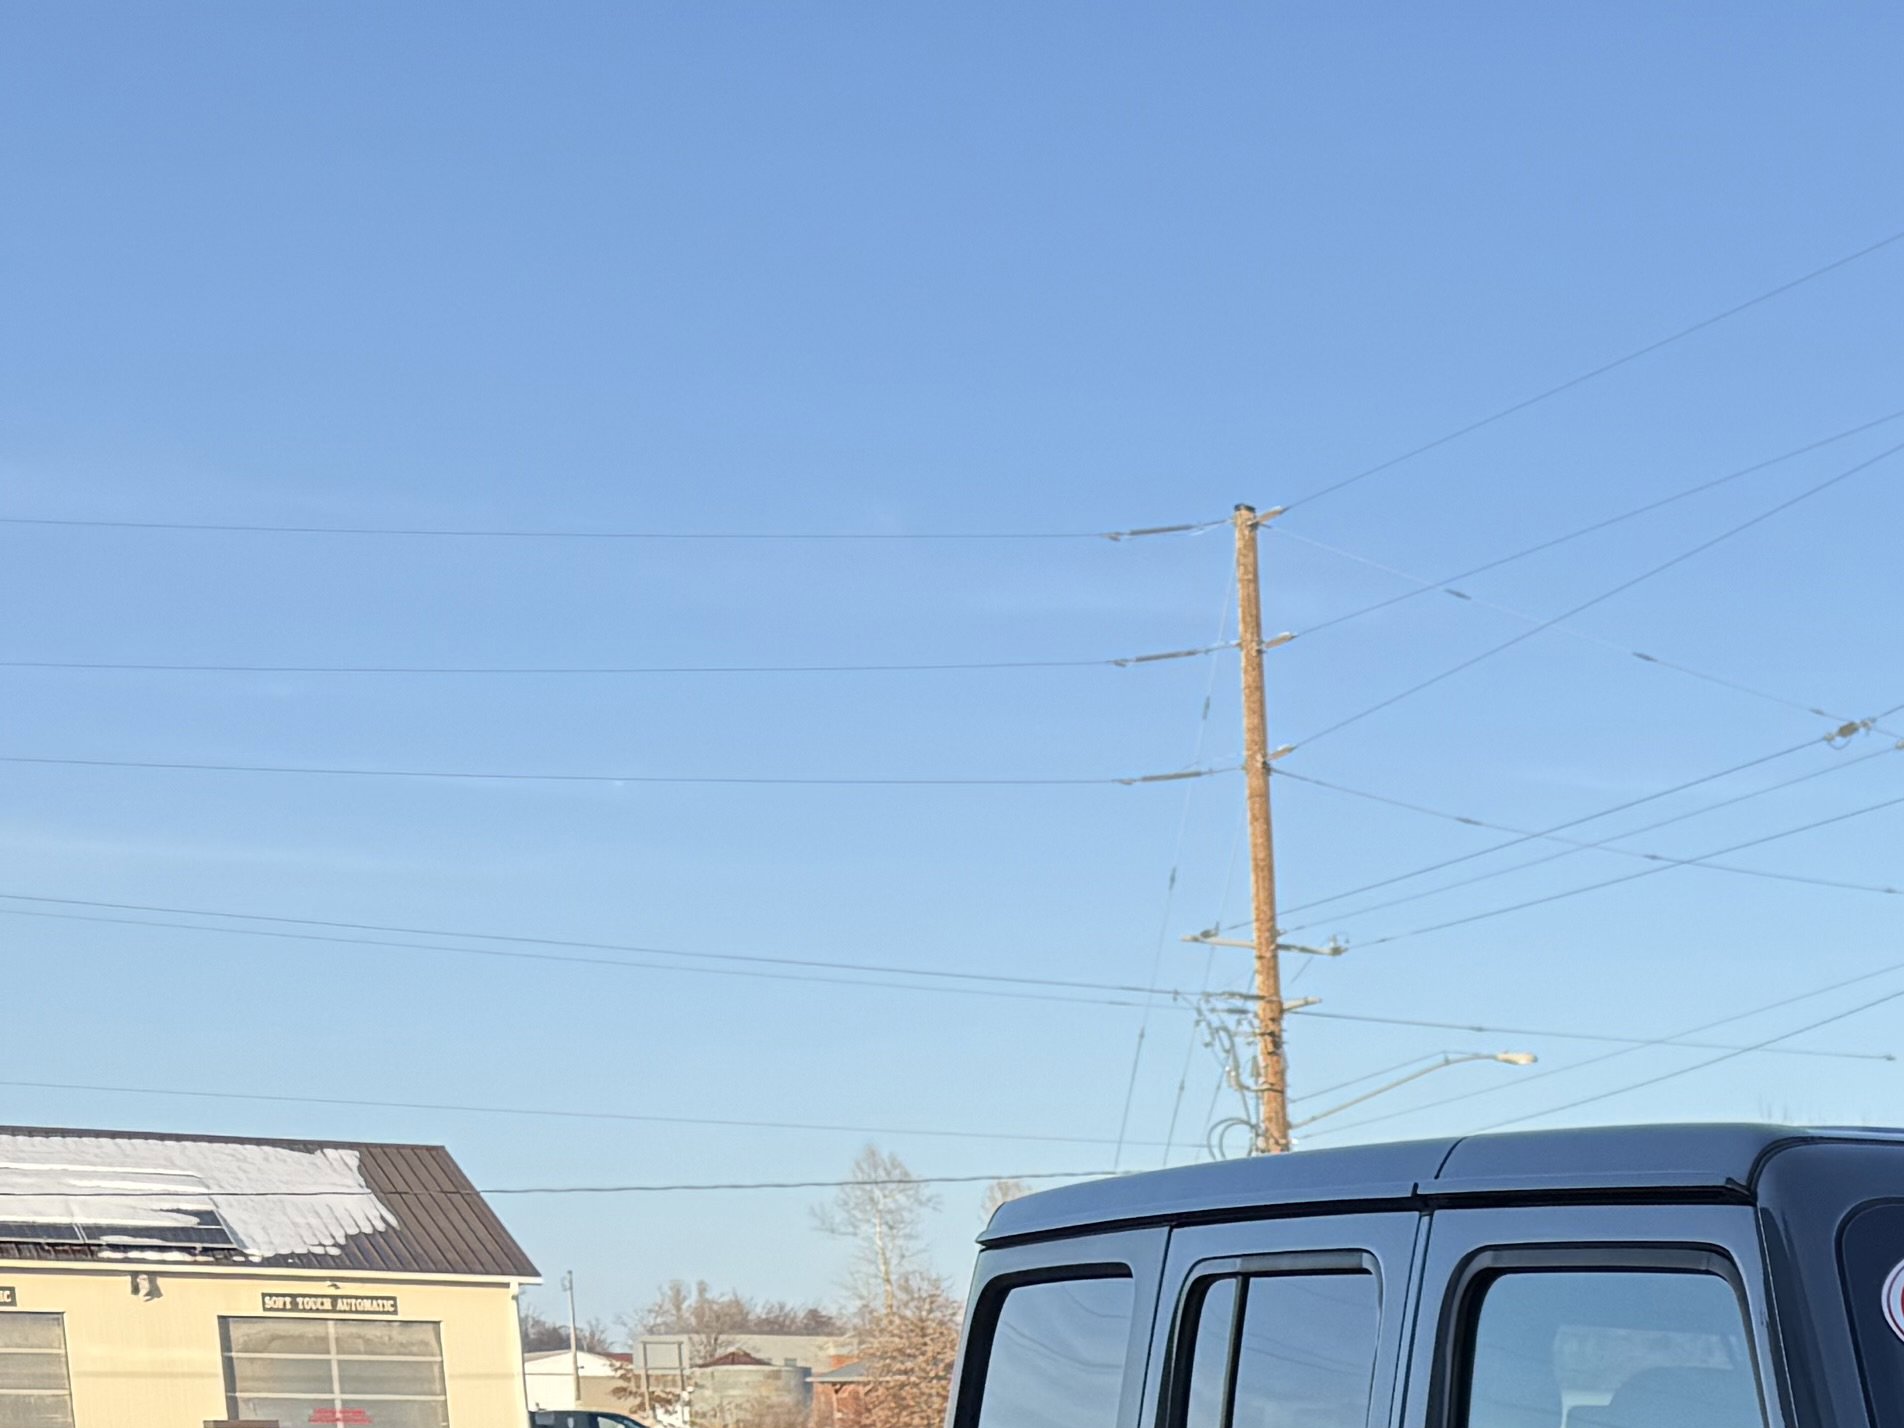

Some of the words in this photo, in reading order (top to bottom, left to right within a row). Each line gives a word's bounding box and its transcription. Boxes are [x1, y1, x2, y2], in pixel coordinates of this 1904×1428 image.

[264, 1296, 292, 1309] SOFT
[296, 1297, 333, 1310] TOUCH
[336, 1298, 395, 1312] AUTOMATIC
